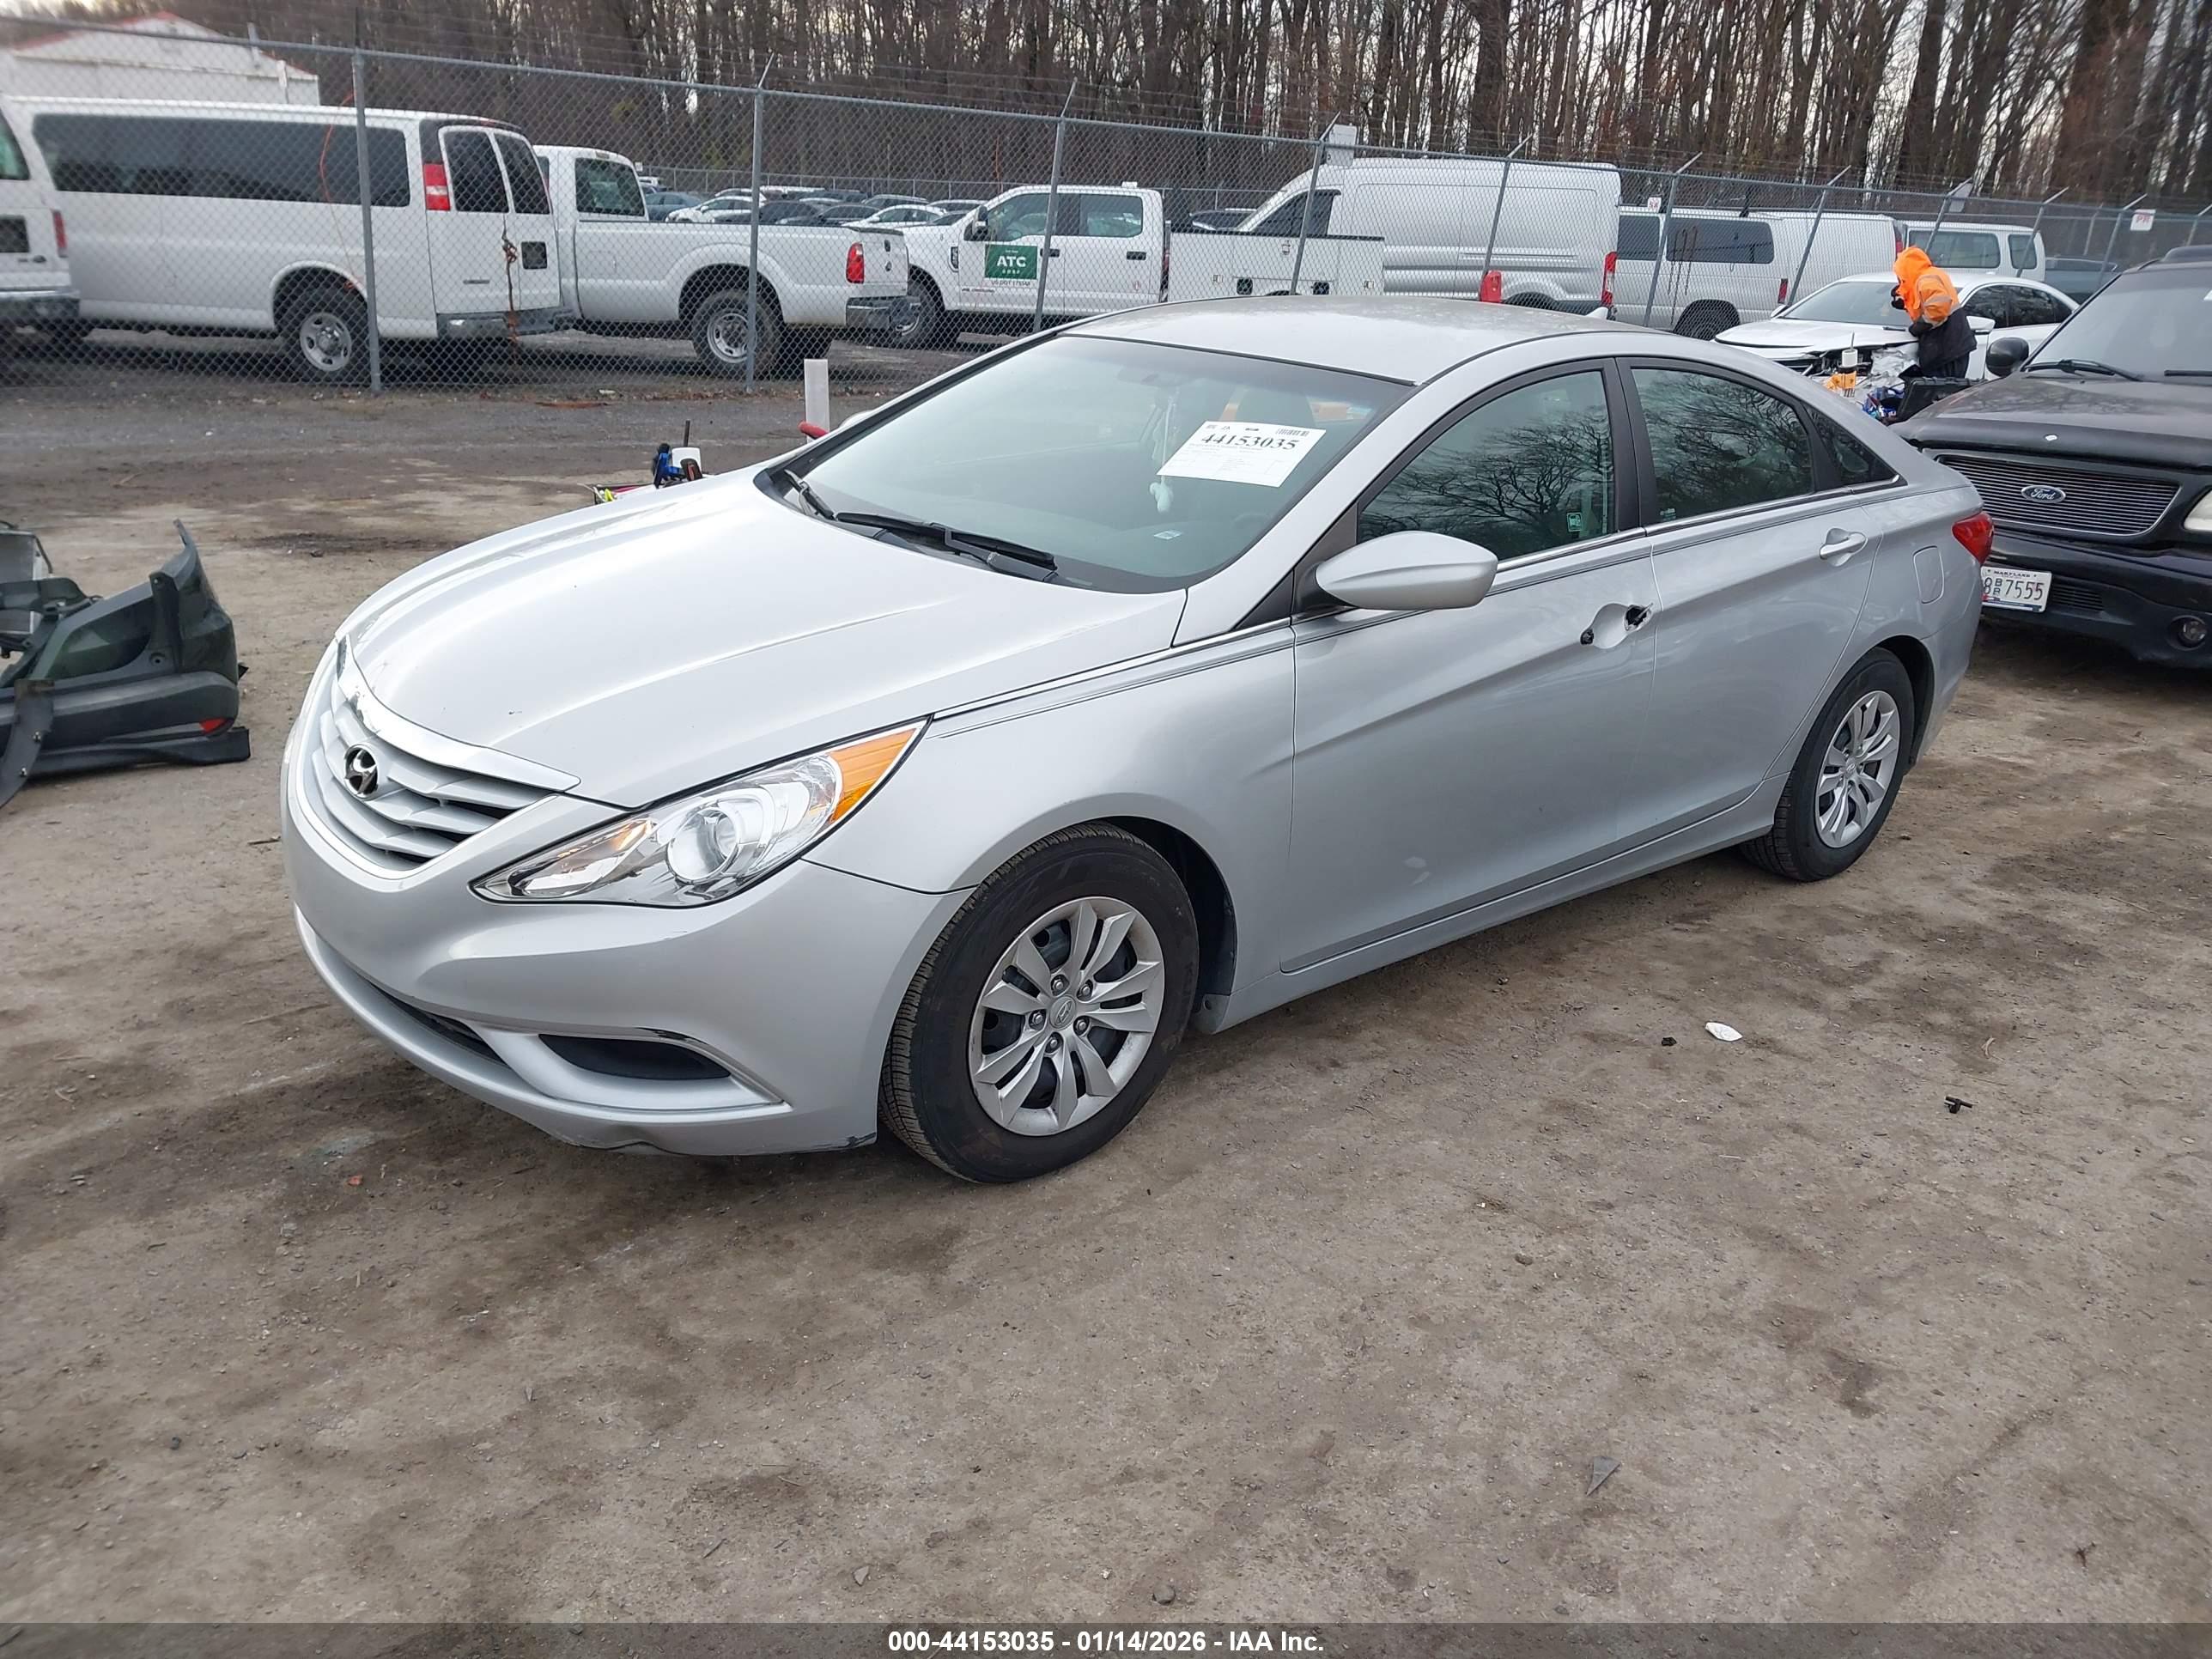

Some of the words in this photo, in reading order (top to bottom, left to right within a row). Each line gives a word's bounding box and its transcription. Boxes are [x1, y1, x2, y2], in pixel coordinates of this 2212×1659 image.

[997, 255, 1027, 268] ATC
[1200, 432, 1300, 451] 44153035
[2030, 487, 2057, 500] Ford
[1994, 569, 2031, 578] MARYLAND
